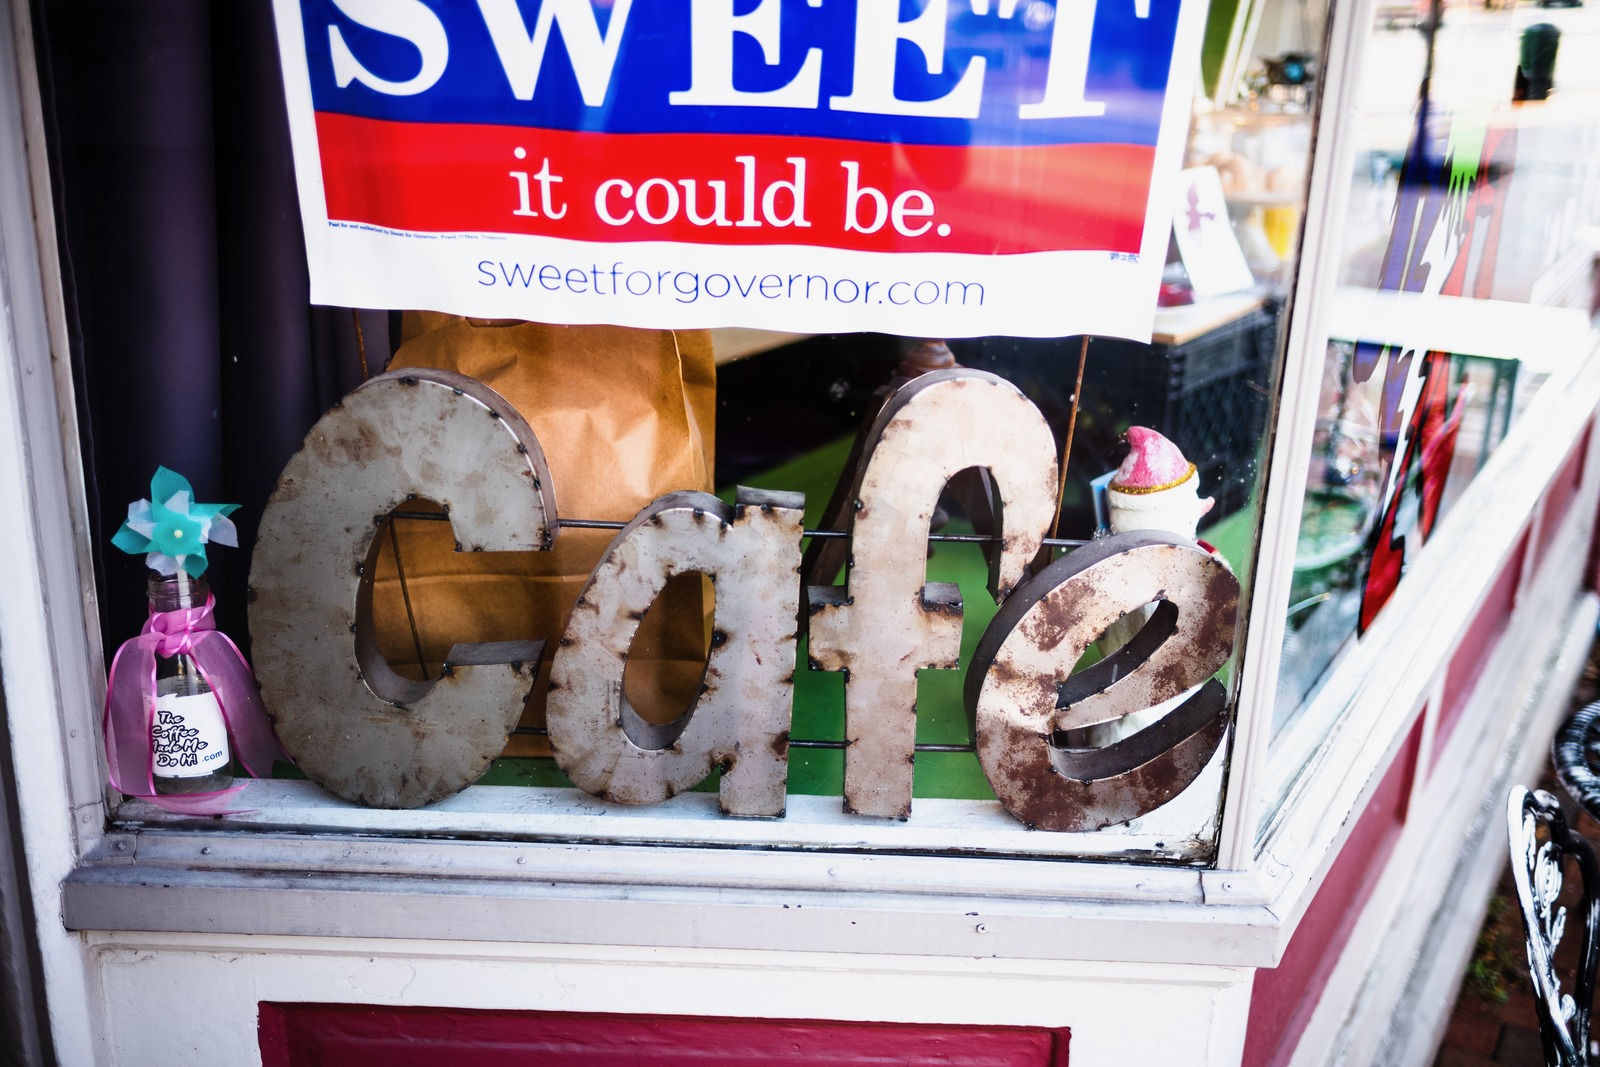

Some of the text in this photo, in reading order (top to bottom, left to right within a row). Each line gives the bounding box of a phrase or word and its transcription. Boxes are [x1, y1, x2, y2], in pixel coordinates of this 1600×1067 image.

[327, 0, 1150, 119] SWEET
[508, 146, 952, 237] it could be.
[476, 259, 986, 306] sweetforgovernor.com
[158, 710, 185, 724] The
[152, 725, 199, 741] Coffee
[182, 737, 208, 753] Me
[157, 750, 223, 767] Do It! .com
